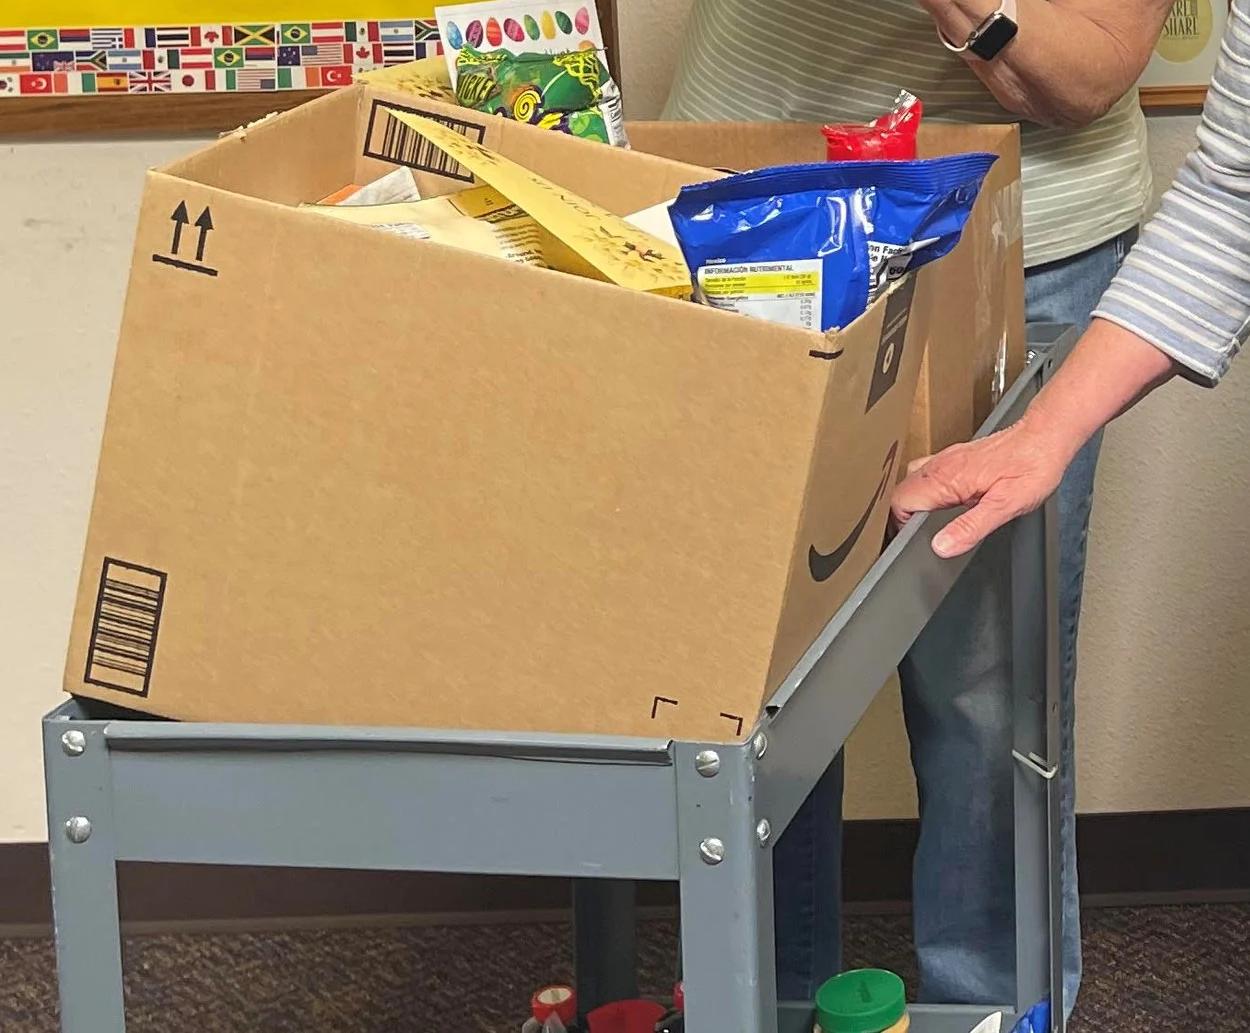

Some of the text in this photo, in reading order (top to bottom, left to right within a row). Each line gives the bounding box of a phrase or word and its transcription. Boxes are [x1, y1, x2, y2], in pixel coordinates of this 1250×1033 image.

[1163, 17, 1199, 36] SHARE
[705, 264, 793, 274] INFORMACIÓN NUTRIMENTAL
